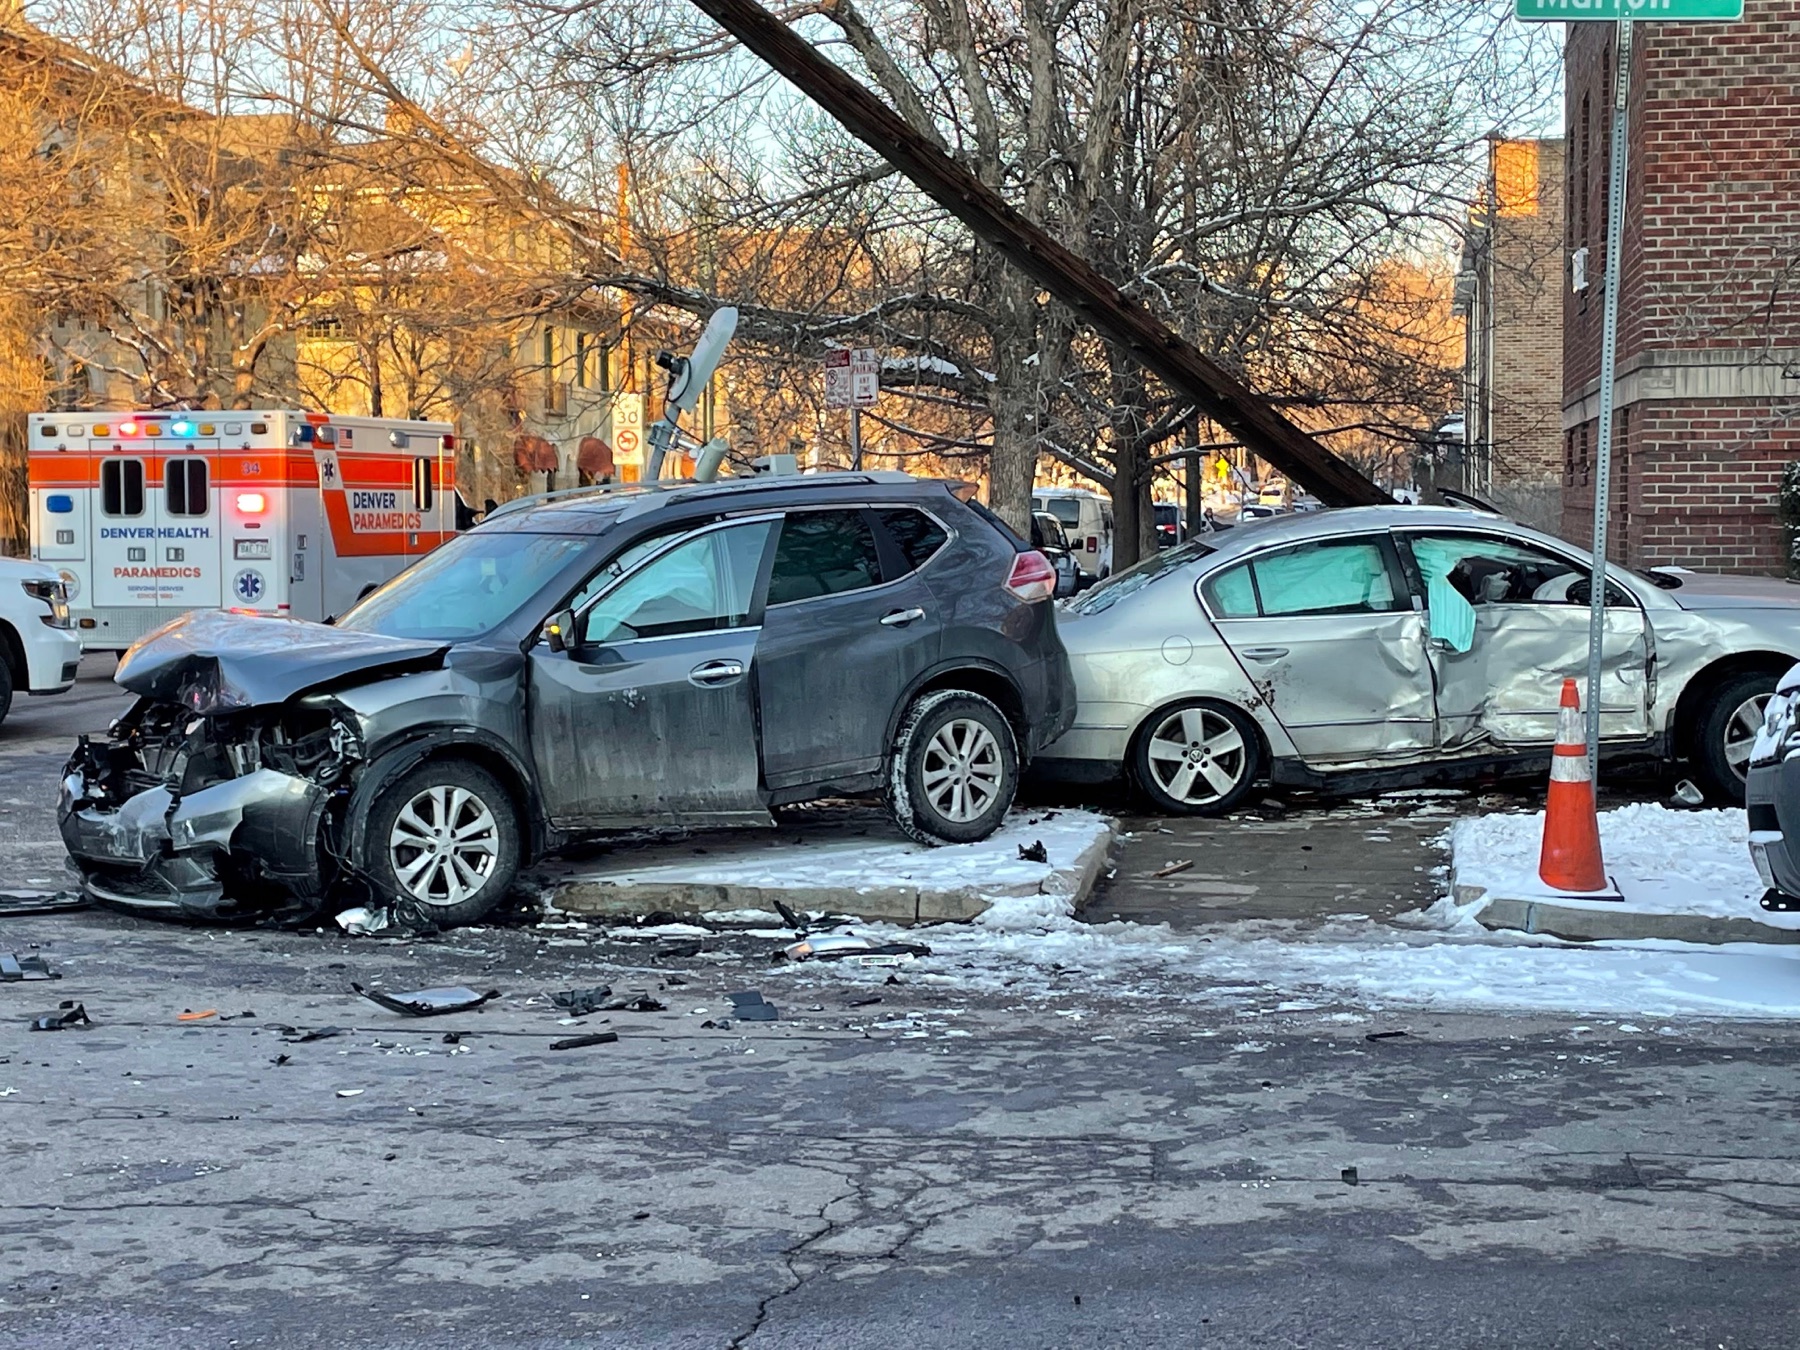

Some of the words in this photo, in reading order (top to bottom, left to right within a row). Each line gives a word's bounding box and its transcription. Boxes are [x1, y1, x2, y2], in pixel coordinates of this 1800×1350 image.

[617, 411, 638, 424] 30
[242, 461, 260, 475] 34
[353, 492, 396, 509] DENVER
[354, 512, 421, 530] PARAMEDICS
[101, 527, 155, 538] DENVER
[157, 527, 209, 538] HEALTH
[113, 567, 201, 578] PARAMEDICS
